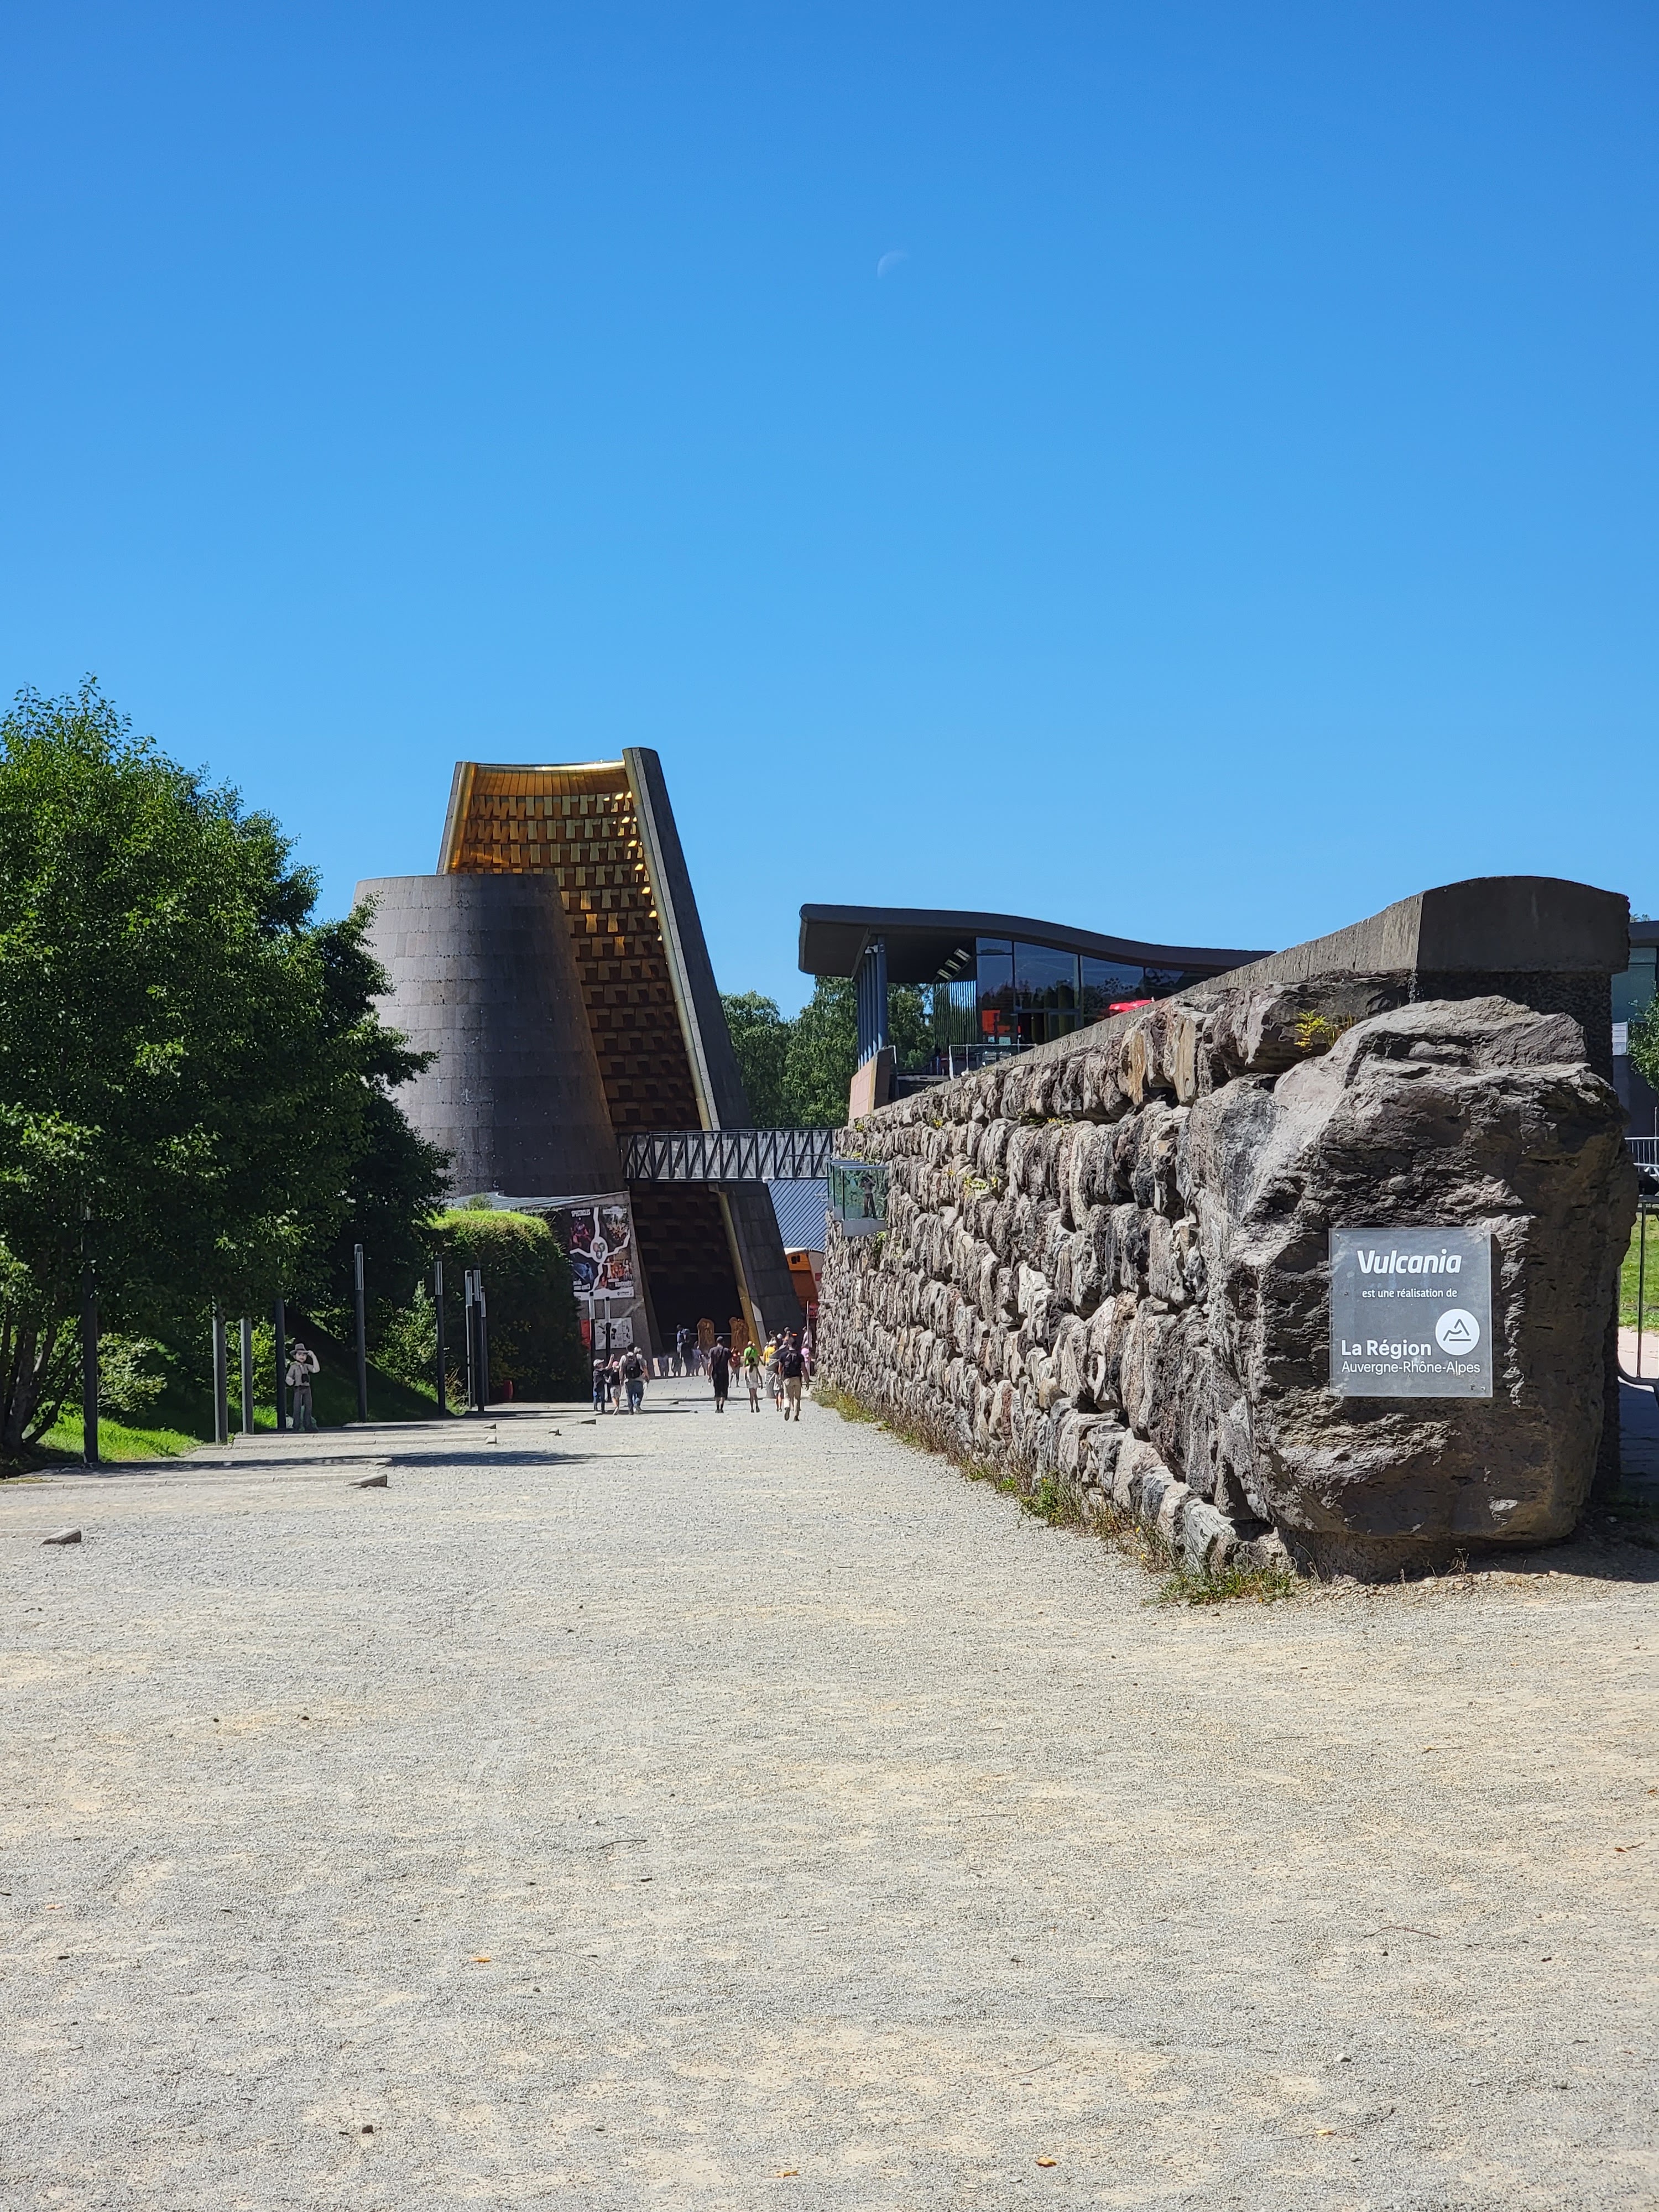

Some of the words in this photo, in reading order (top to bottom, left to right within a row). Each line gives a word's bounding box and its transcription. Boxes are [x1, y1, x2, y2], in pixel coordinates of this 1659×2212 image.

[1357, 1248, 1462, 1274] Vulcania
[1362, 1290, 1375, 1298] est
[1397, 1288, 1443, 1298] réalisation
[1446, 1288, 1458, 1298] de
[1341, 1339, 1362, 1356] La
[1367, 1339, 1432, 1360] Région
[1342, 1360, 1480, 1375] Auvergne-Rhône-Alpes
